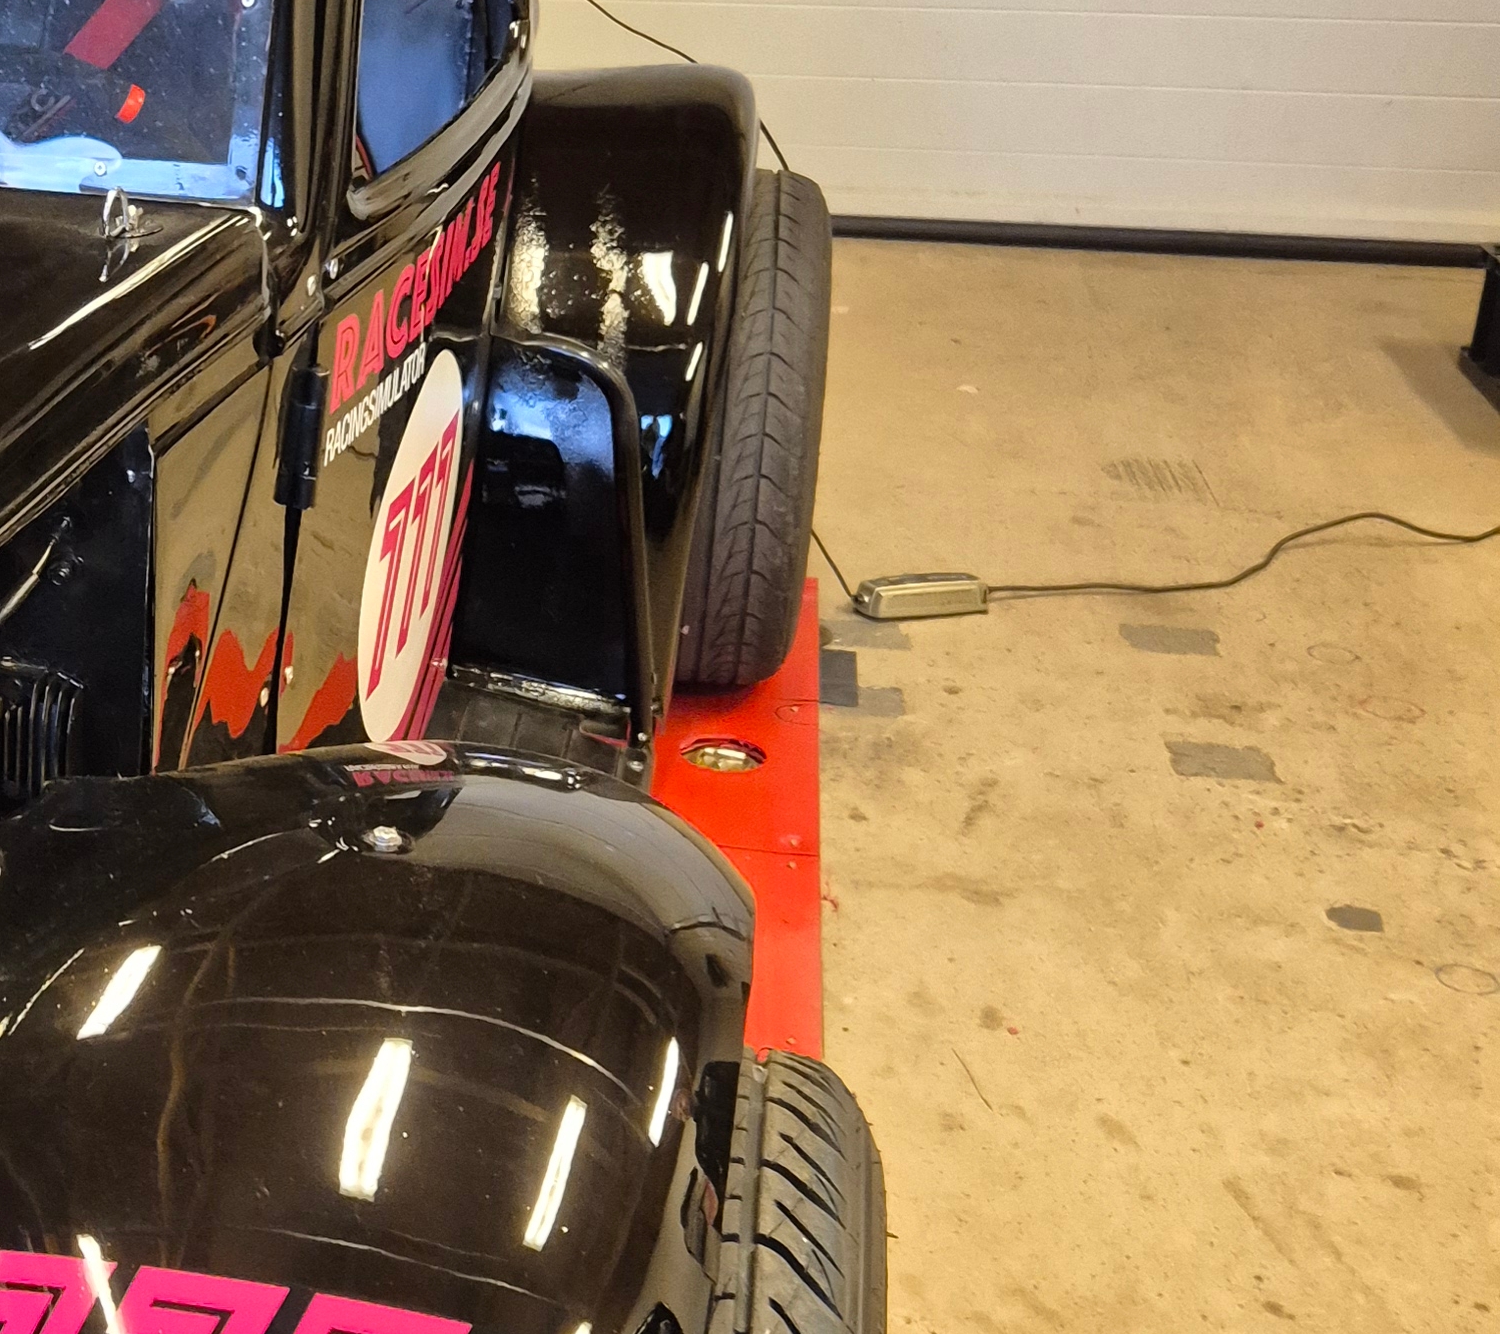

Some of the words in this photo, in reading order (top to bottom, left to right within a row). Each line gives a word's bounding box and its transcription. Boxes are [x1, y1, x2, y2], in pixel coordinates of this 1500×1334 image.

[323, 342, 426, 467] RACINGSIMULATOR
[328, 161, 501, 416] RACESIM.SE
[365, 408, 460, 702] 777
